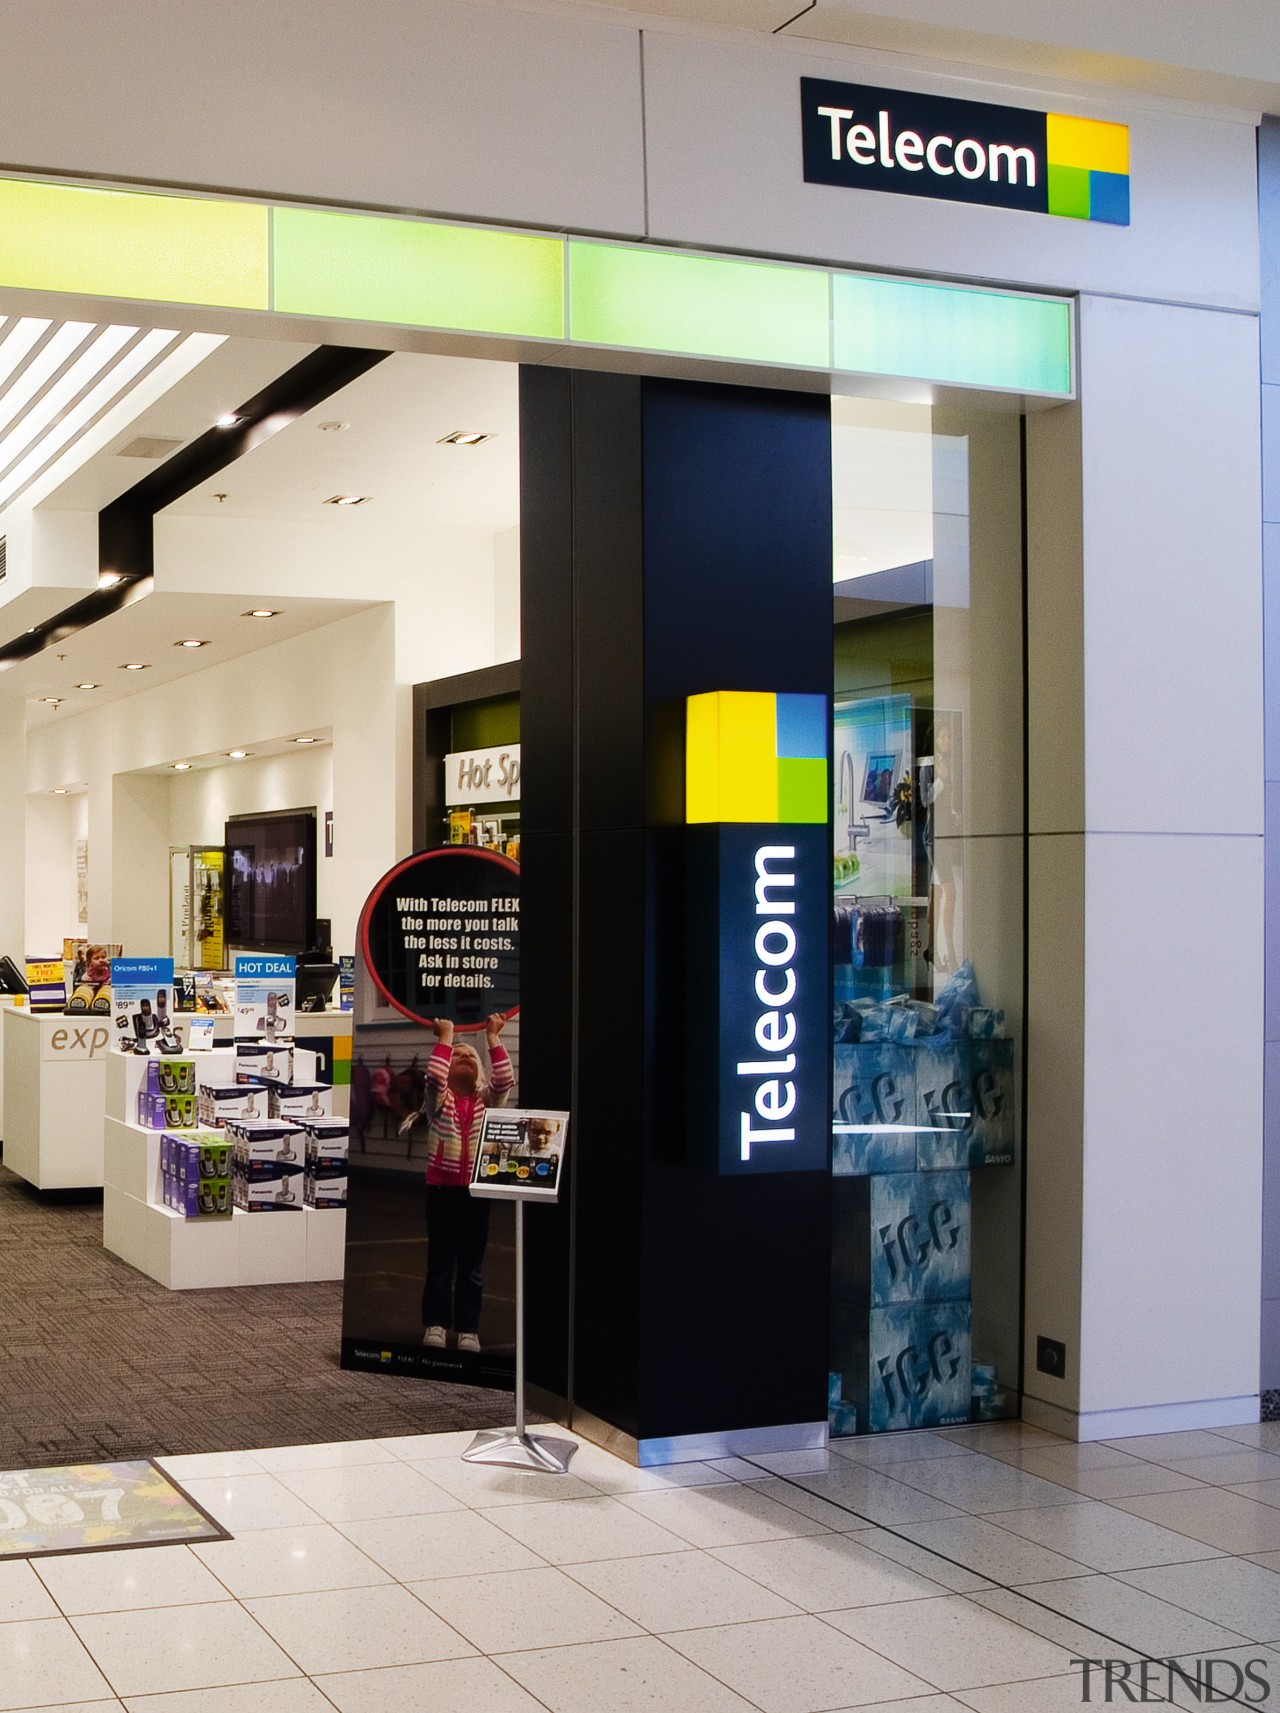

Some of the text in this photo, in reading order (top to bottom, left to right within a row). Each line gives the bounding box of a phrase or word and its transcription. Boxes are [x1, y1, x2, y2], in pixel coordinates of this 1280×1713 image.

[817, 106, 1036, 187] Telecom
[458, 753, 520, 796] Hot Sp
[396, 898, 520, 912] With Telecom FLEX
[402, 916, 519, 932] the more you talk
[404, 935, 515, 950] the less it costs.
[239, 962, 292, 973] HOT DEAL
[418, 954, 498, 969] Ask in store
[422, 973, 494, 988] for details.
[736, 845, 797, 1160] Telecom
[984, 1154, 1012, 1164] SANYO
[354, 1350, 380, 1359] Telecom
[13, 1488, 44, 1496] FOR
[50, 1485, 78, 1494] ALL
